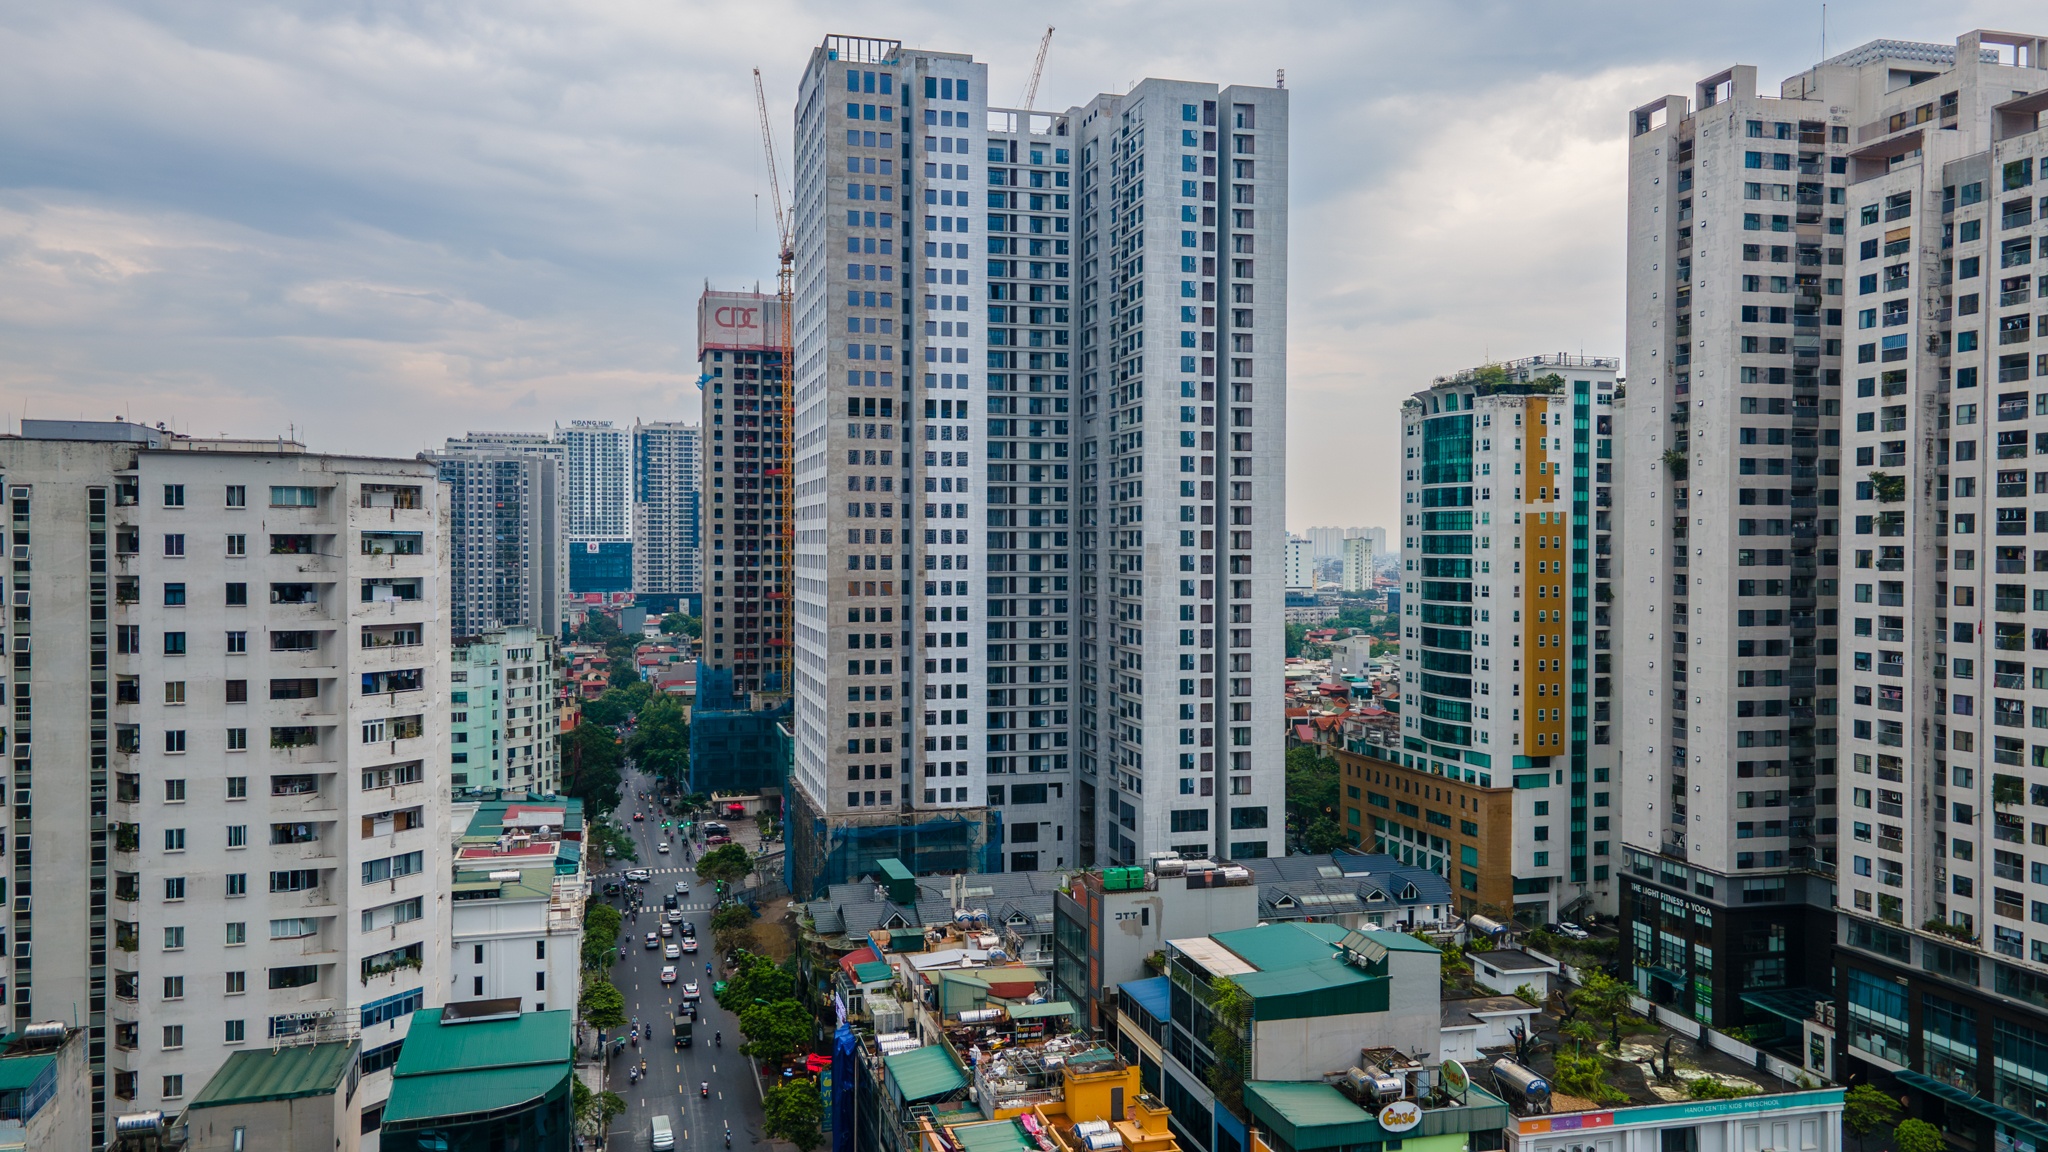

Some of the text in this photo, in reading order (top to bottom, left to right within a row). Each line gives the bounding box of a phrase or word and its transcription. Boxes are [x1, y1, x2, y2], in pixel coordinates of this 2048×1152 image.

[714, 306, 758, 329] CDC
[1630, 882, 1641, 893] THE
[1642, 886, 1660, 899] LIGHT
[1660, 892, 1684, 907] FITNESS
[1690, 902, 1712, 917] YOGA
[1684, 1099, 1780, 1114] HANOI CENTER KIDS PRESCHOOL
